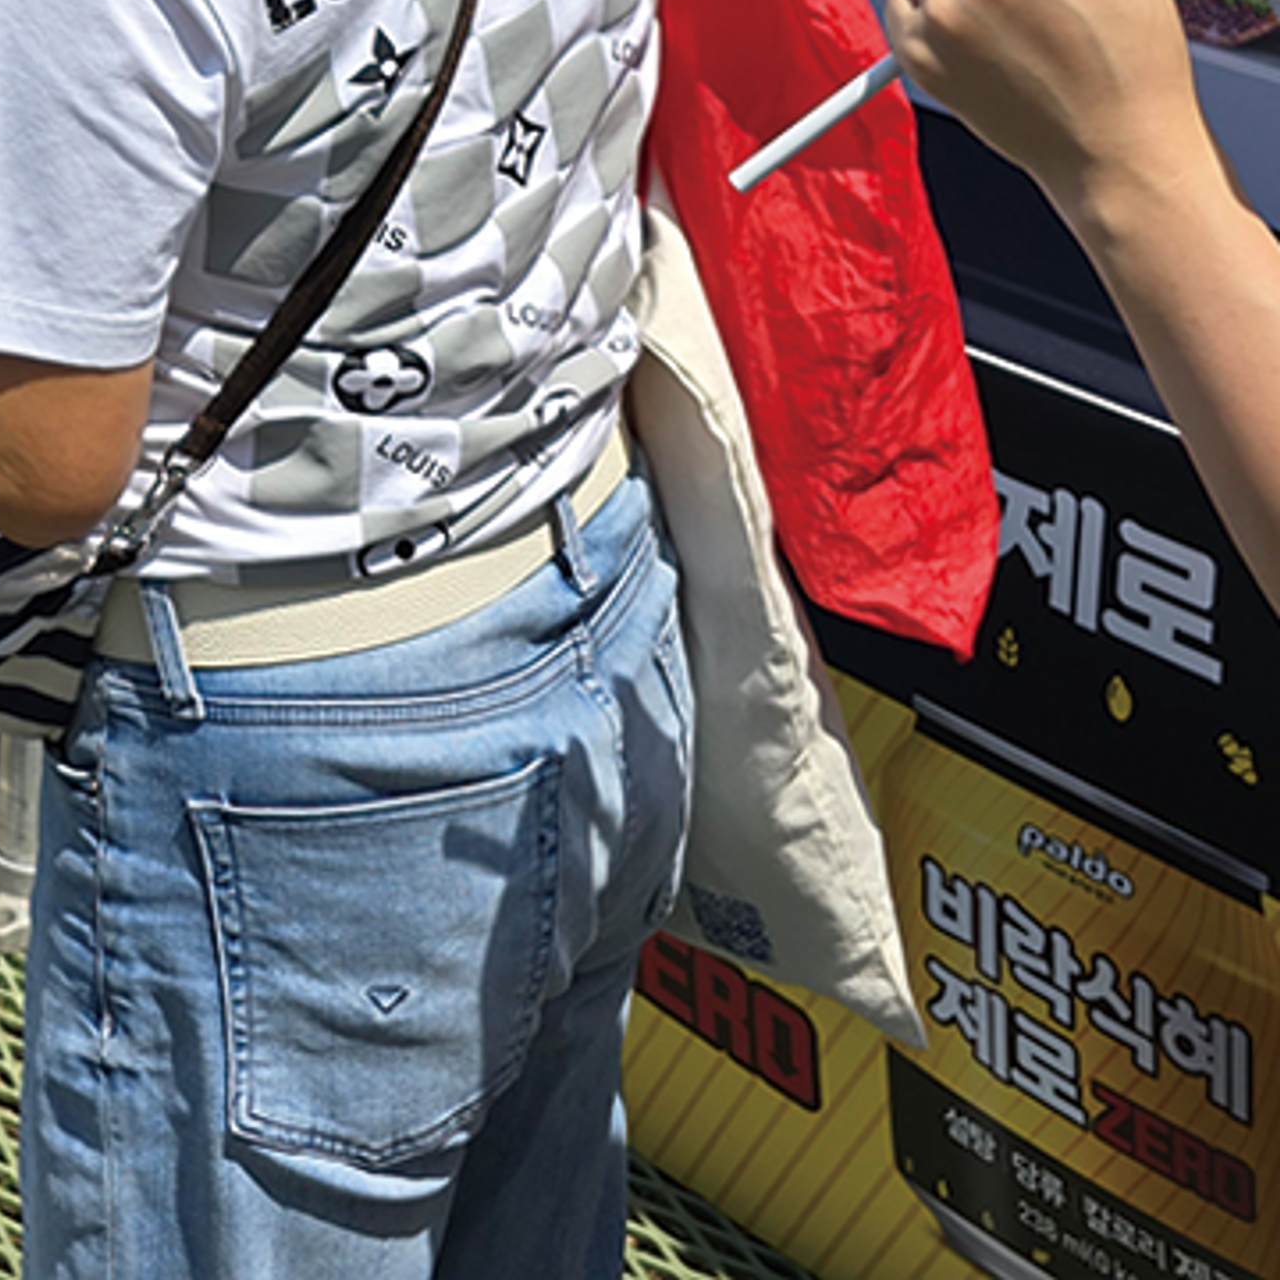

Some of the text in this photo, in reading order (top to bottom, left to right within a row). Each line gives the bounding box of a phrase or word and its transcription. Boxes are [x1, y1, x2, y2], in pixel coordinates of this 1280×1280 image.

[375, 434, 452, 489] LOUIS
[992, 468, 1223, 685] 제로
[1018, 822, 1135, 899] paldo
[637, 930, 821, 1112] ERO
[921, 856, 1253, 1128] 비락식혜
[923, 955, 1257, 1224] 제로 ZERO
[1173, 1247, 1233, 1280] 제
